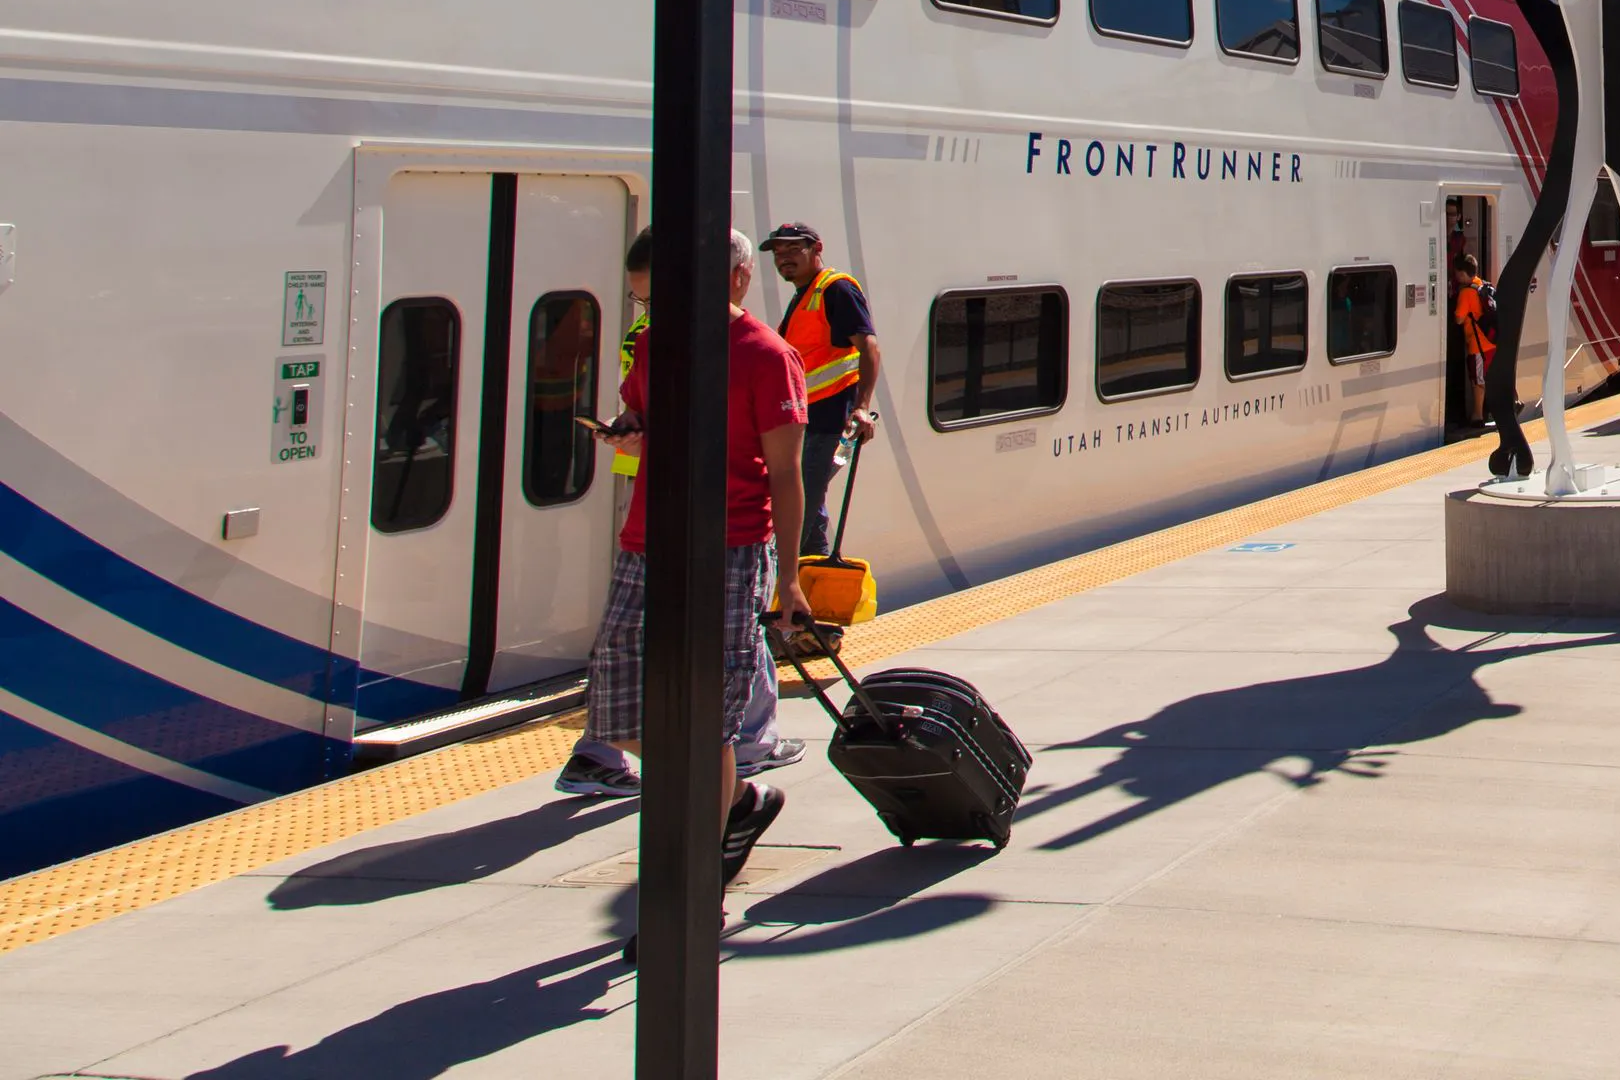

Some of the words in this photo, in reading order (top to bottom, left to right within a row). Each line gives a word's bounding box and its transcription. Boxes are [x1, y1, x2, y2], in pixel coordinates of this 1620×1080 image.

[1026, 131, 1301, 182] FRONTRUNNER
[288, 363, 315, 377] TAP
[1053, 430, 1101, 457] UTAH
[1117, 413, 1190, 443] TRANSIT
[1201, 393, 1285, 426] AUTHORITY
[289, 431, 307, 445] TO
[279, 445, 316, 461] OPEN
